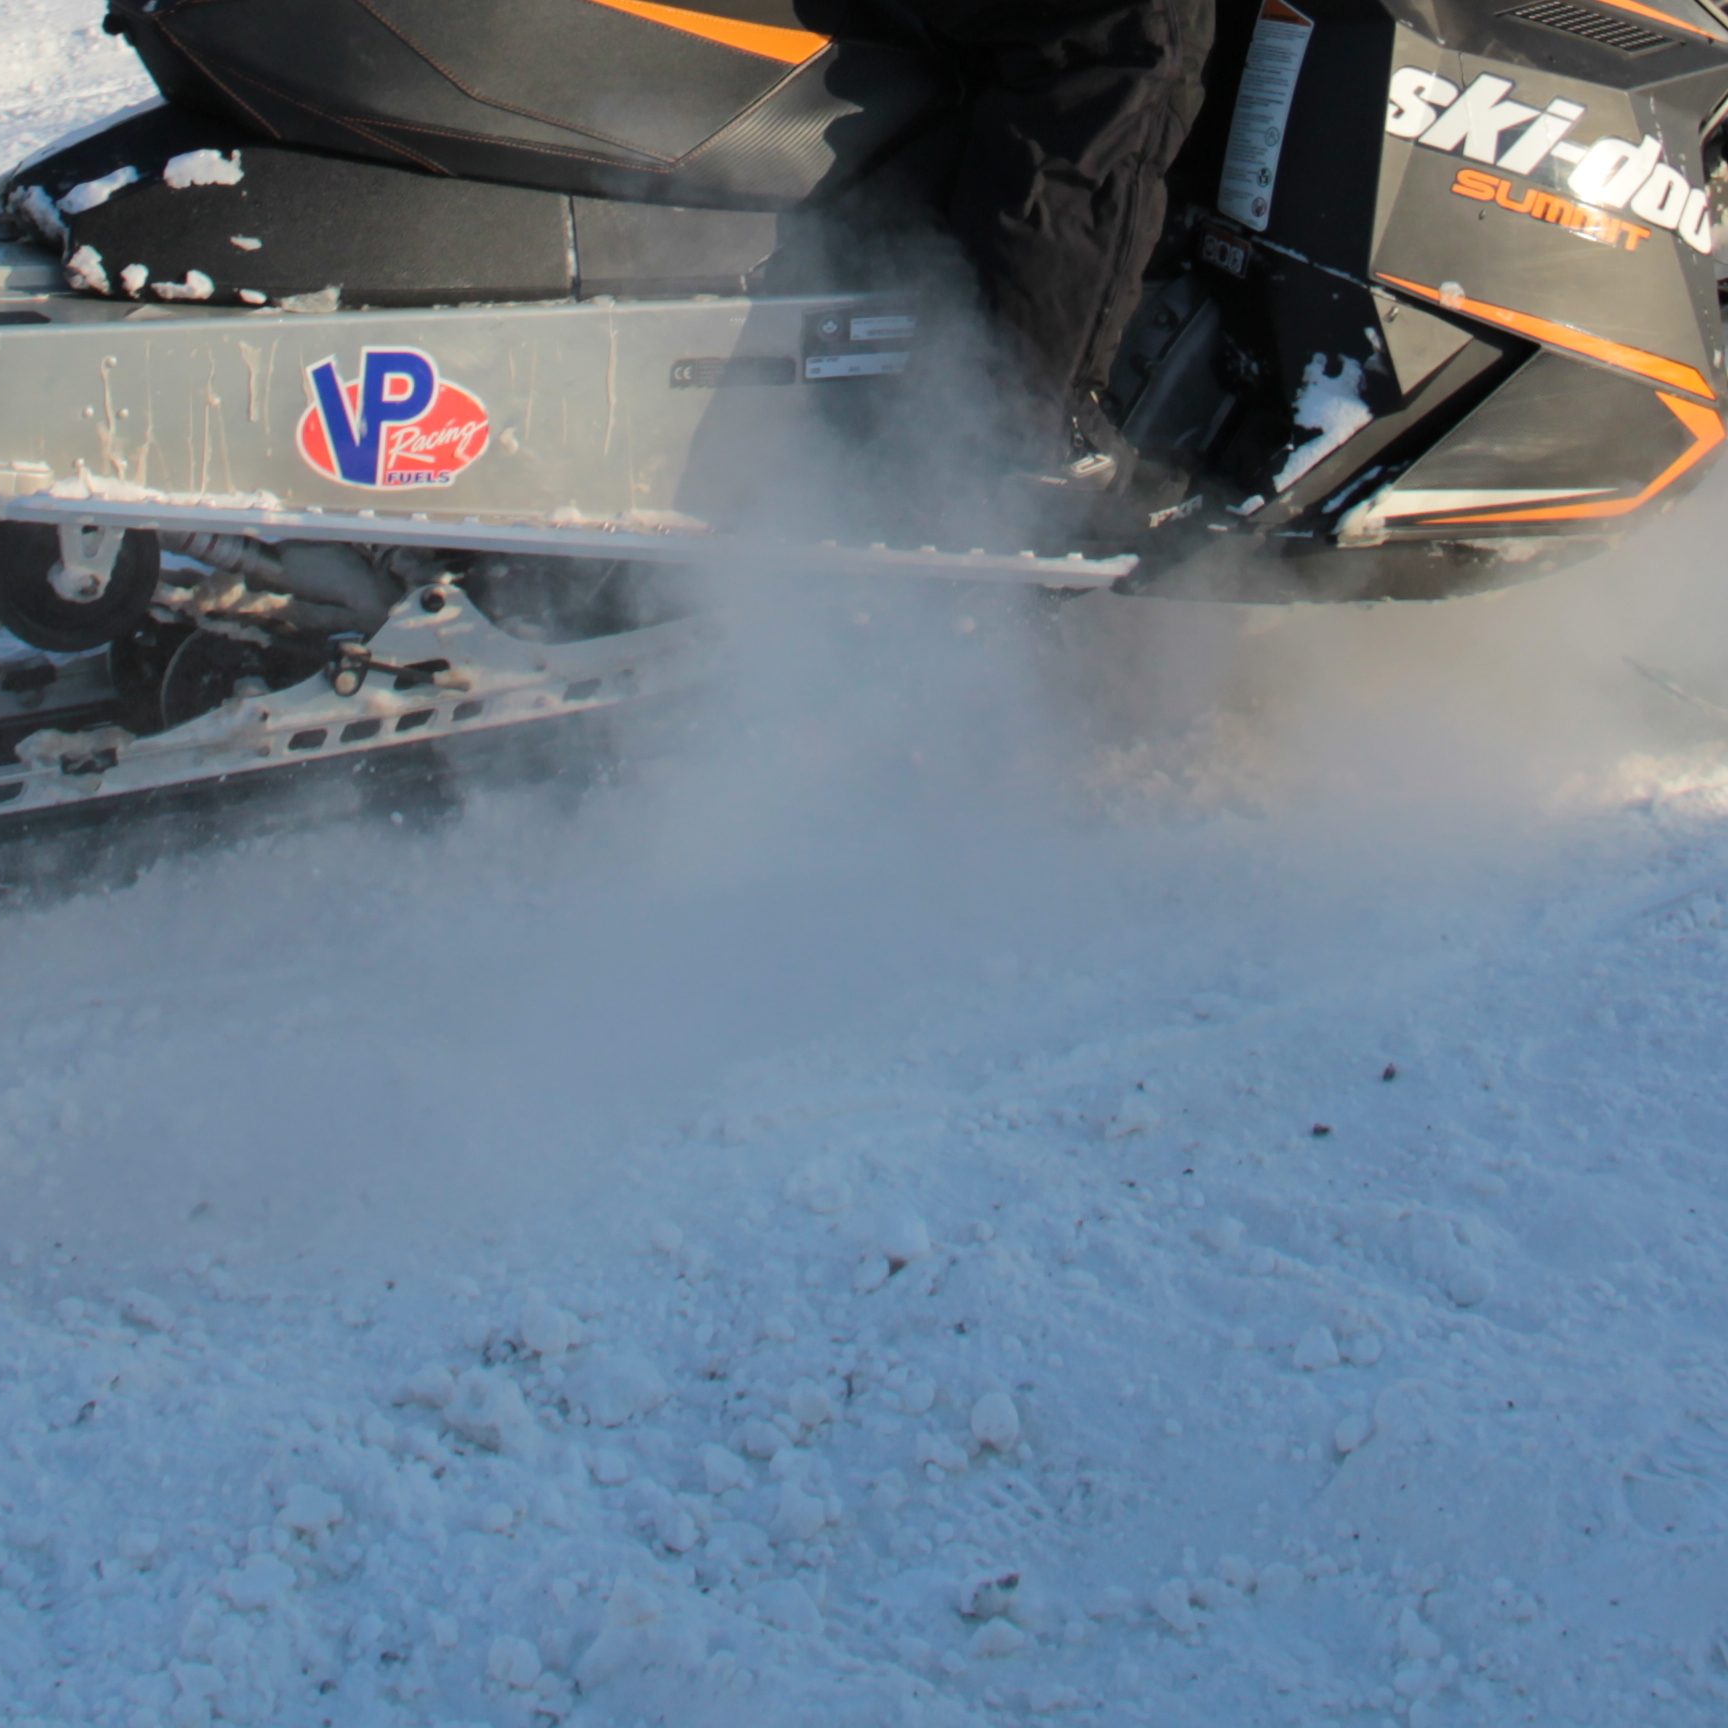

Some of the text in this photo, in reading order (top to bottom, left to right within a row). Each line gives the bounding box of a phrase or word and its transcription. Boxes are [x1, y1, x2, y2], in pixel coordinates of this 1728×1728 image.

[1450, 168, 1652, 252] SUMMIT
[306, 345, 440, 488] VP
[387, 418, 490, 471] Racing
[387, 471, 452, 485] FUELS
